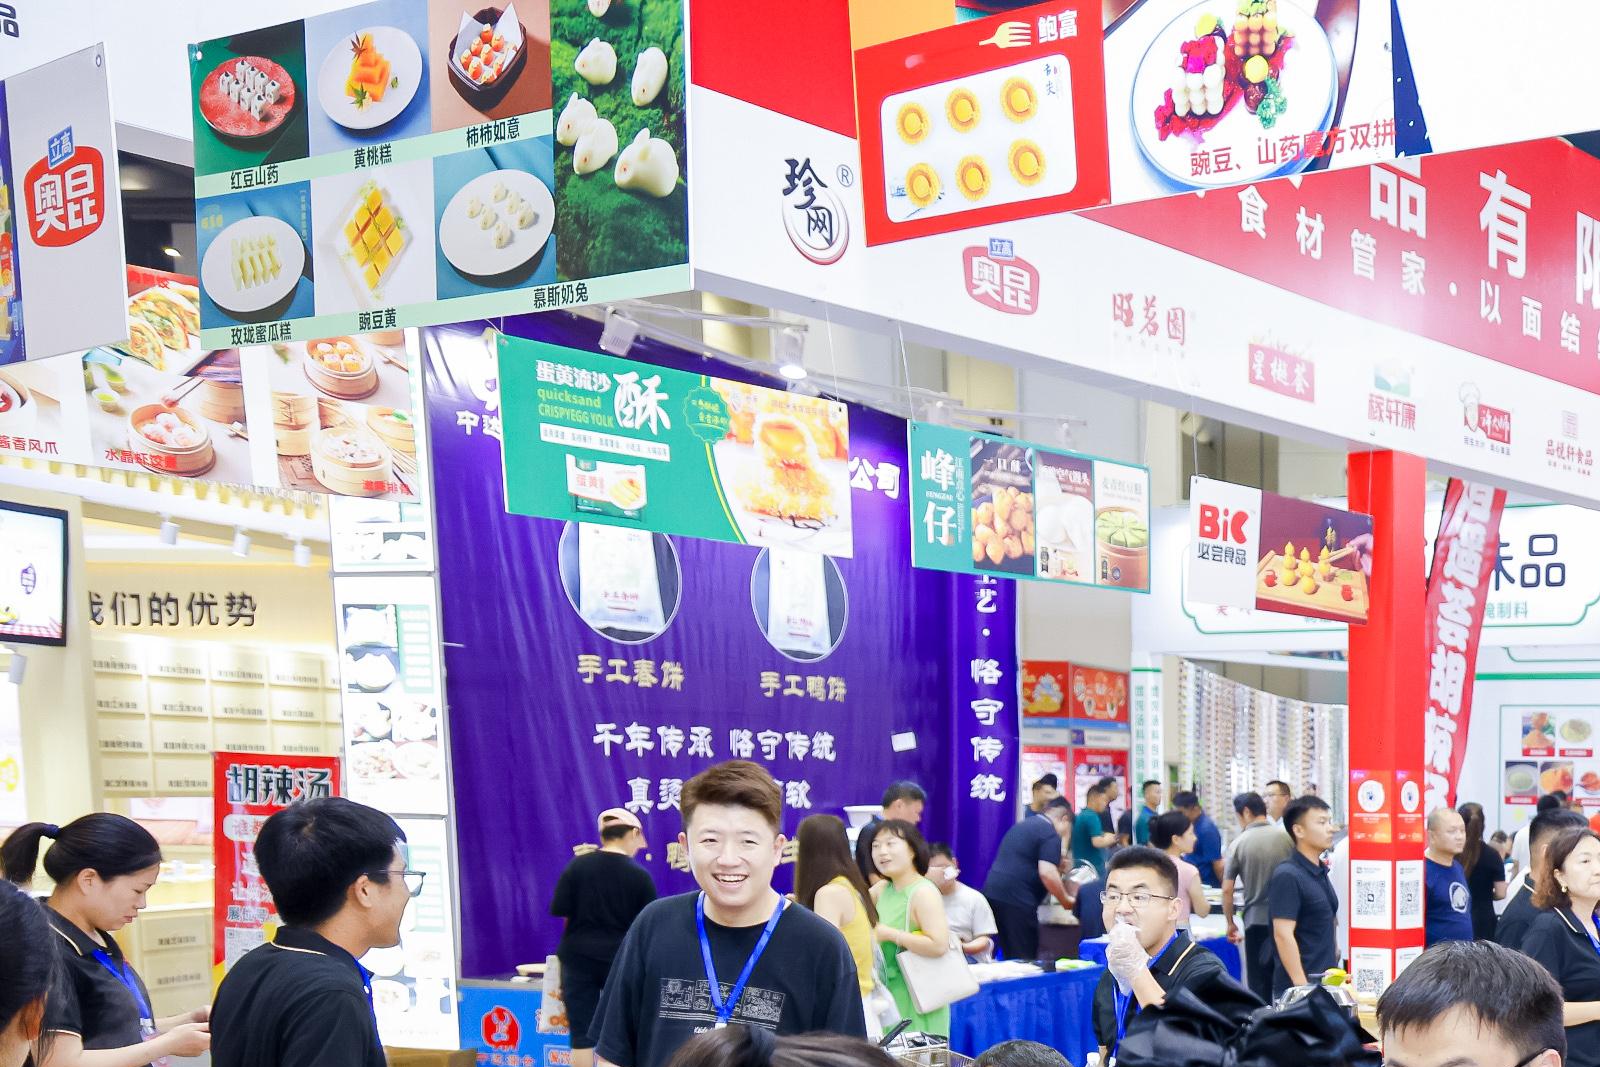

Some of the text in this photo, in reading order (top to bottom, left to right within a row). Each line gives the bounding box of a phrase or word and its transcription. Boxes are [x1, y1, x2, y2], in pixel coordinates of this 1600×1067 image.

[1038, 10, 1078, 43] 鲍富
[50, 130, 73, 161] 立高
[466, 116, 520, 148] 柿柿如意
[1190, 117, 1396, 176] 豌豆、山药魔方双拼
[354, 143, 392, 169] 黄桃糕
[230, 165, 279, 190] 红豆山药
[34, 163, 98, 238] 奥昆
[533, 281, 590, 309] 慕斯奶兔
[971, 255, 1033, 311] 奥昆
[230, 321, 292, 347] 玫珑蜜瓜糕
[358, 308, 397, 331] 豌豆黄
[536, 359, 612, 393] 蛋黄流沙
[537, 387, 601, 409] quicksand
[613, 371, 672, 436] 酥
[577, 654, 685, 692] 手工春饼
[759, 671, 847, 703] 手工鸭饼
[593, 721, 837, 762] 千年传承 恪守传统
[225, 763, 334, 806] 胡辣汤
